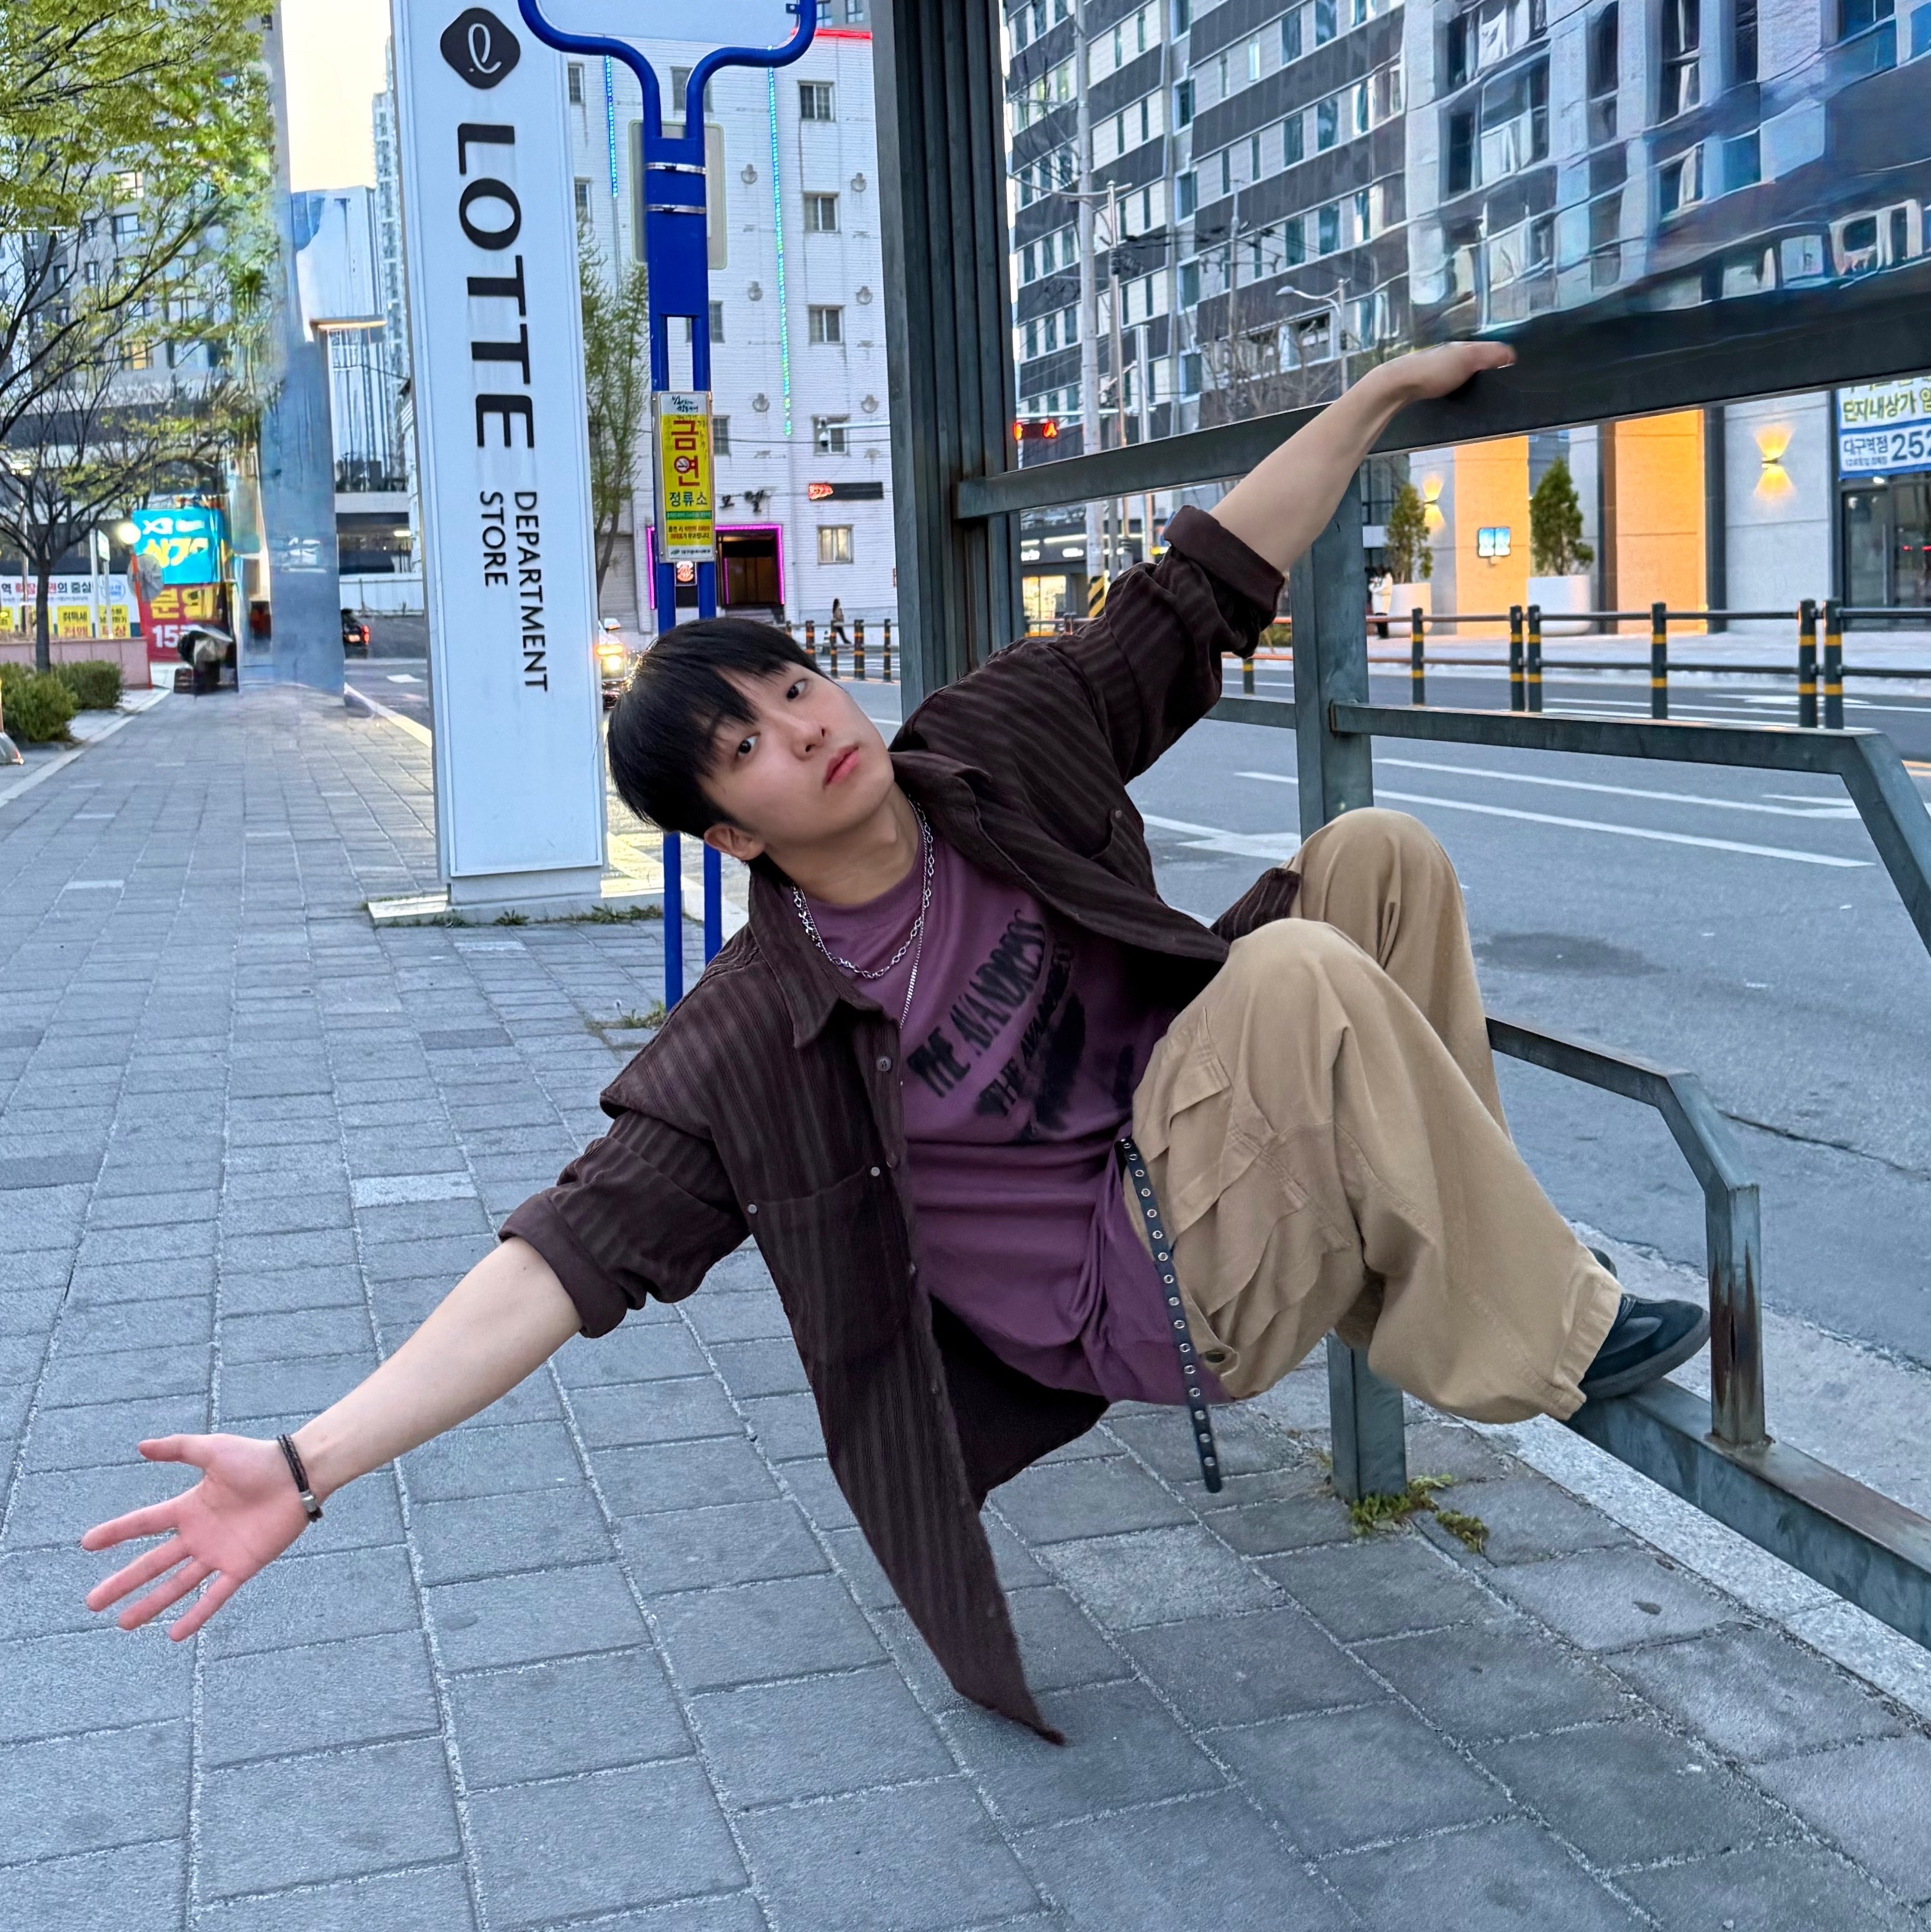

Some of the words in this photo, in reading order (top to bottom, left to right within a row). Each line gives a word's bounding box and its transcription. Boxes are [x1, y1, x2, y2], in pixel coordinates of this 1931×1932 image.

[457, 123, 535, 447] LOTTE
[479, 491, 508, 587] STORE
[669, 491, 708, 507] 정류소
[514, 491, 548, 692] DEPARTMENT
